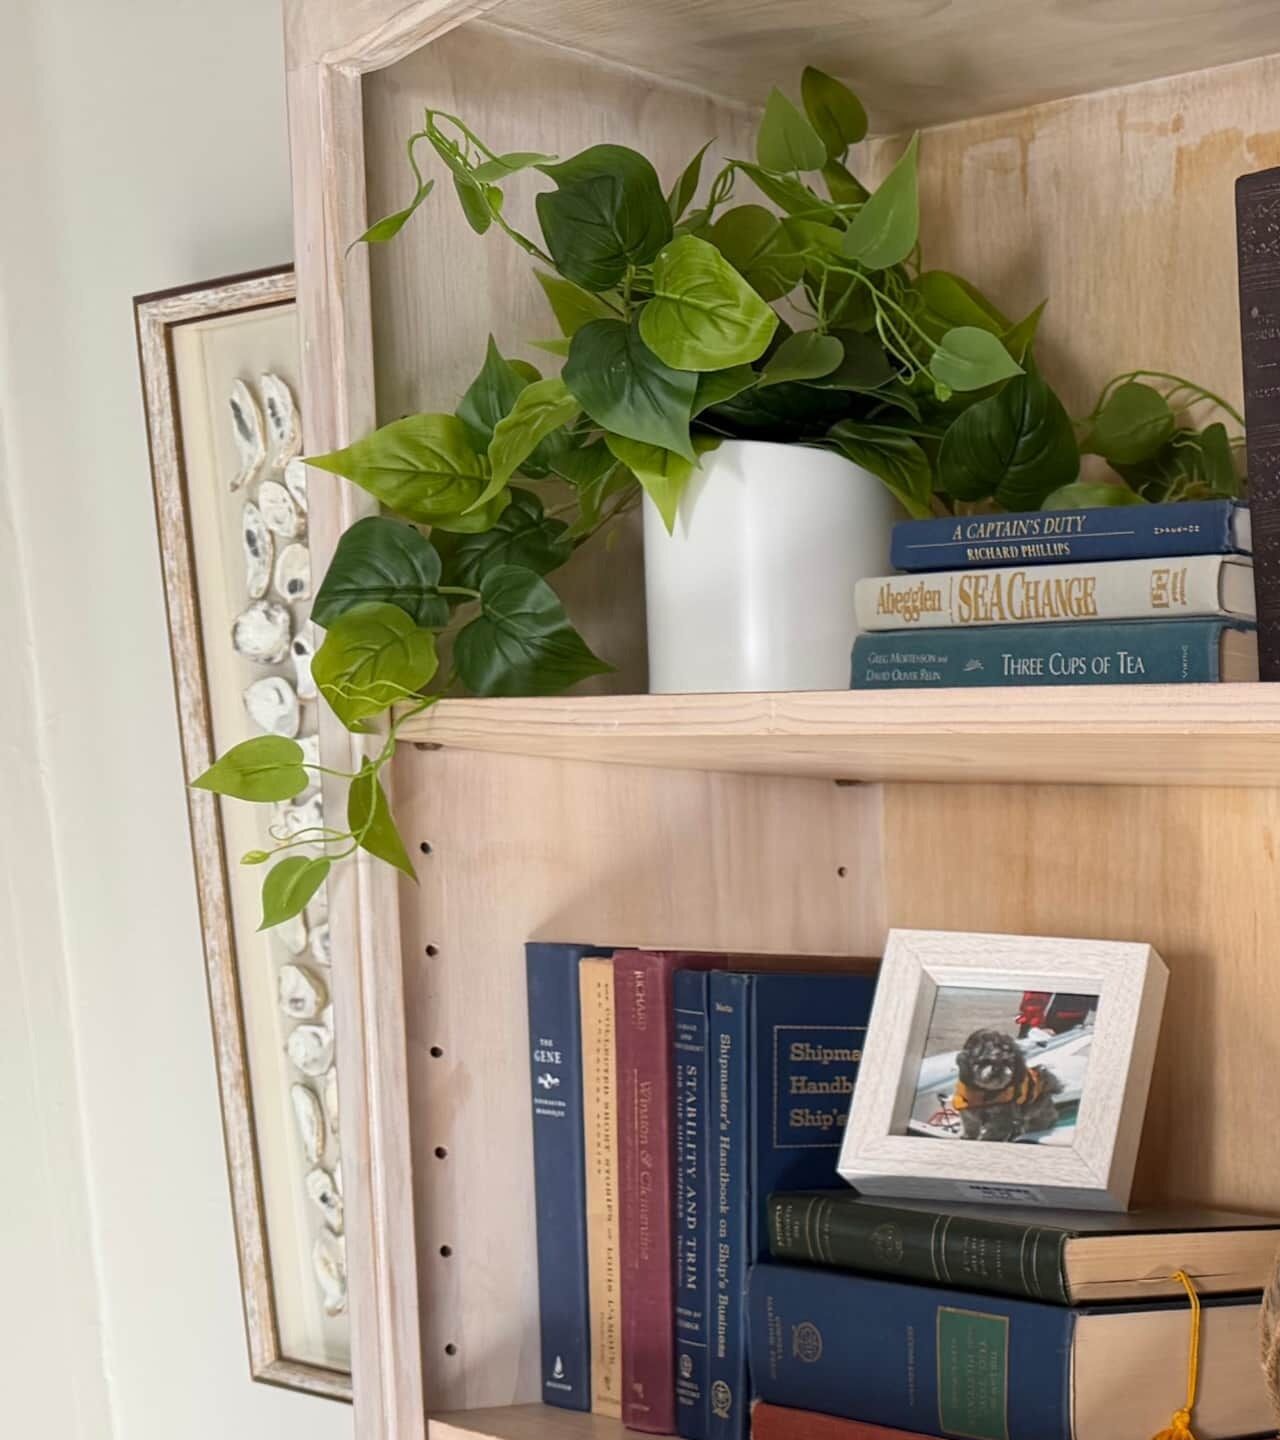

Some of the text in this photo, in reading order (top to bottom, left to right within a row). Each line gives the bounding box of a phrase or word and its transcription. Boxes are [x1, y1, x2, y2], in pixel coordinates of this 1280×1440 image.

[952, 514, 1087, 541] A CAPTAIN'S DUTY
[966, 542, 1071, 561] RICHARD PHILLIPS
[876, 580, 942, 623] Abegglen
[958, 573, 1007, 623] SEA
[1006, 571, 1098, 621] CHANGE
[1001, 651, 1146, 676] THREE CUPS OF TEA
[534, 1049, 562, 1065] GENE
[686, 1064, 698, 1289] STABILITY AND TRIM
[717, 1033, 732, 1358] Shipmaster's Handbook on Ship's Business
